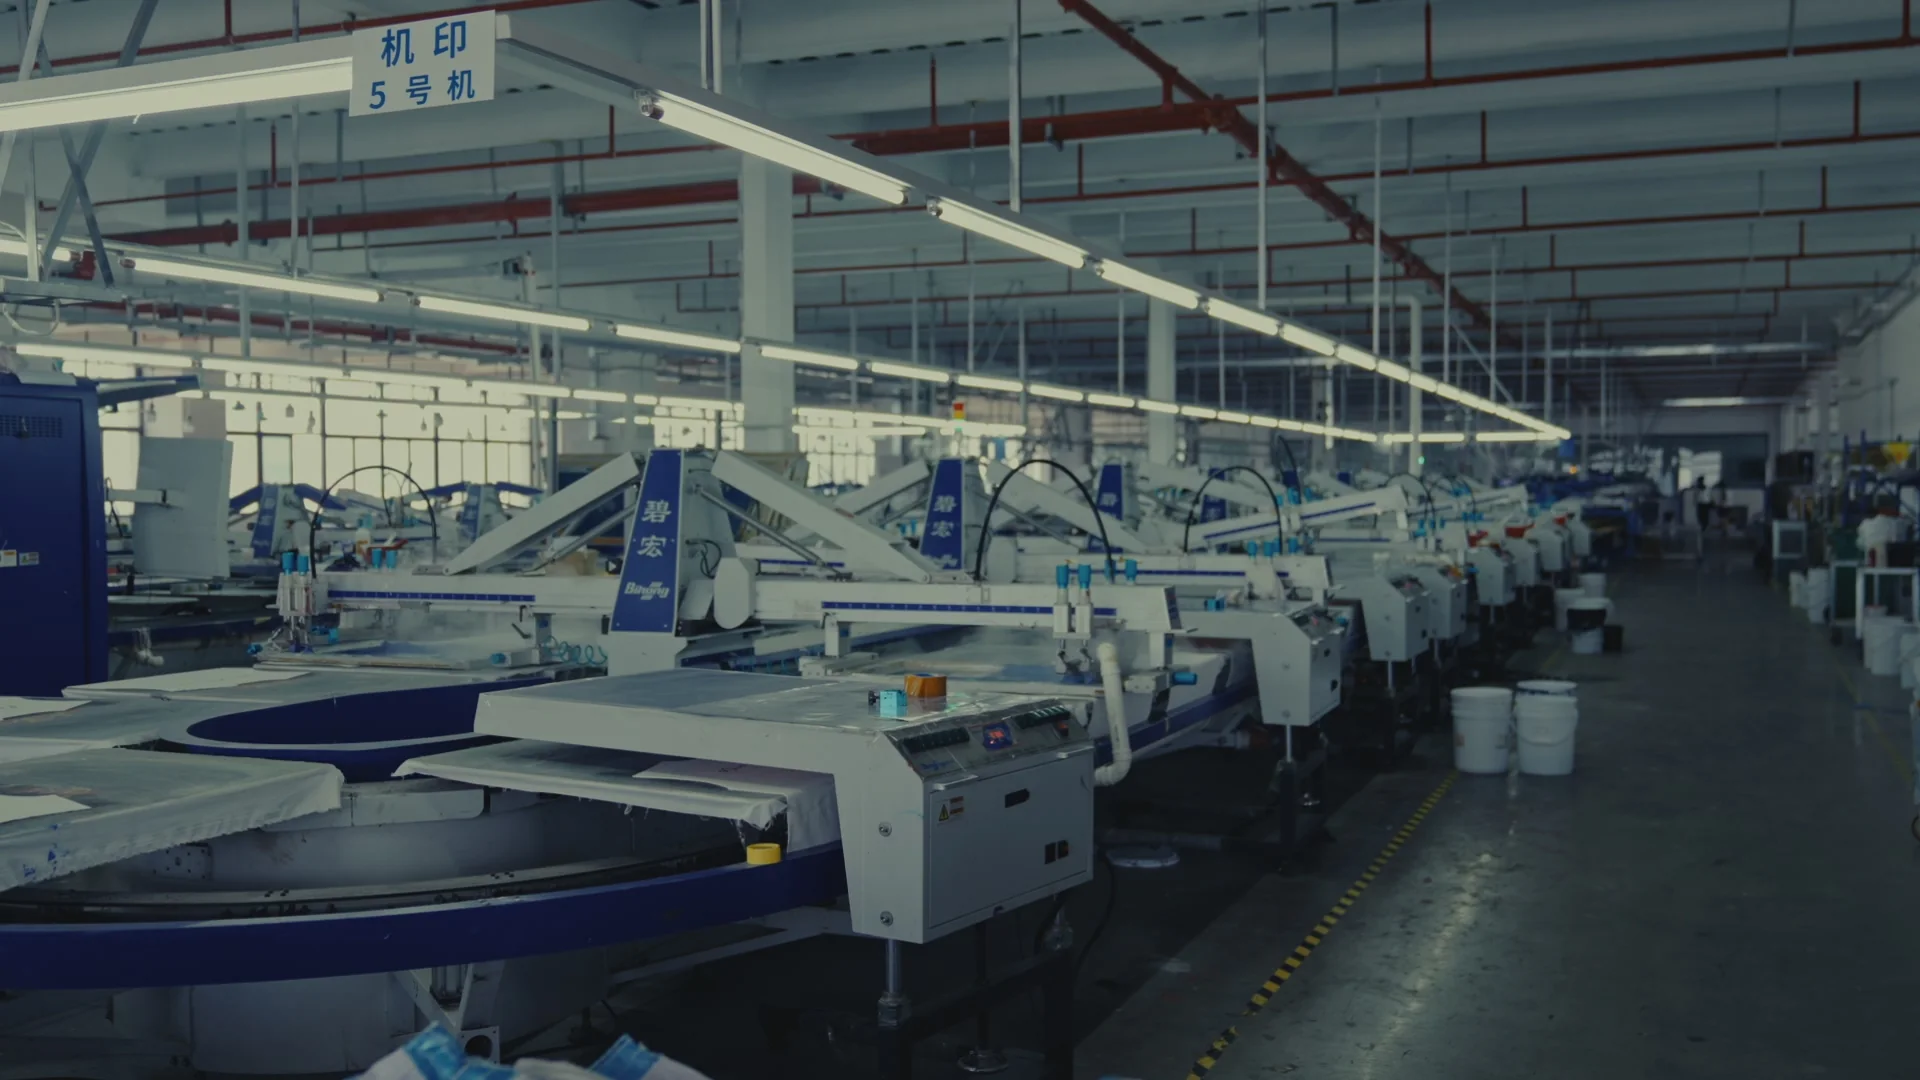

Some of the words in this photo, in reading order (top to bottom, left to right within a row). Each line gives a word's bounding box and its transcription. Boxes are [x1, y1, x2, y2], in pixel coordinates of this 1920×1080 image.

[381, 20, 467, 67] 机印
[369, 70, 475, 110] 5号机
[637, 498, 672, 558] 碧宏
